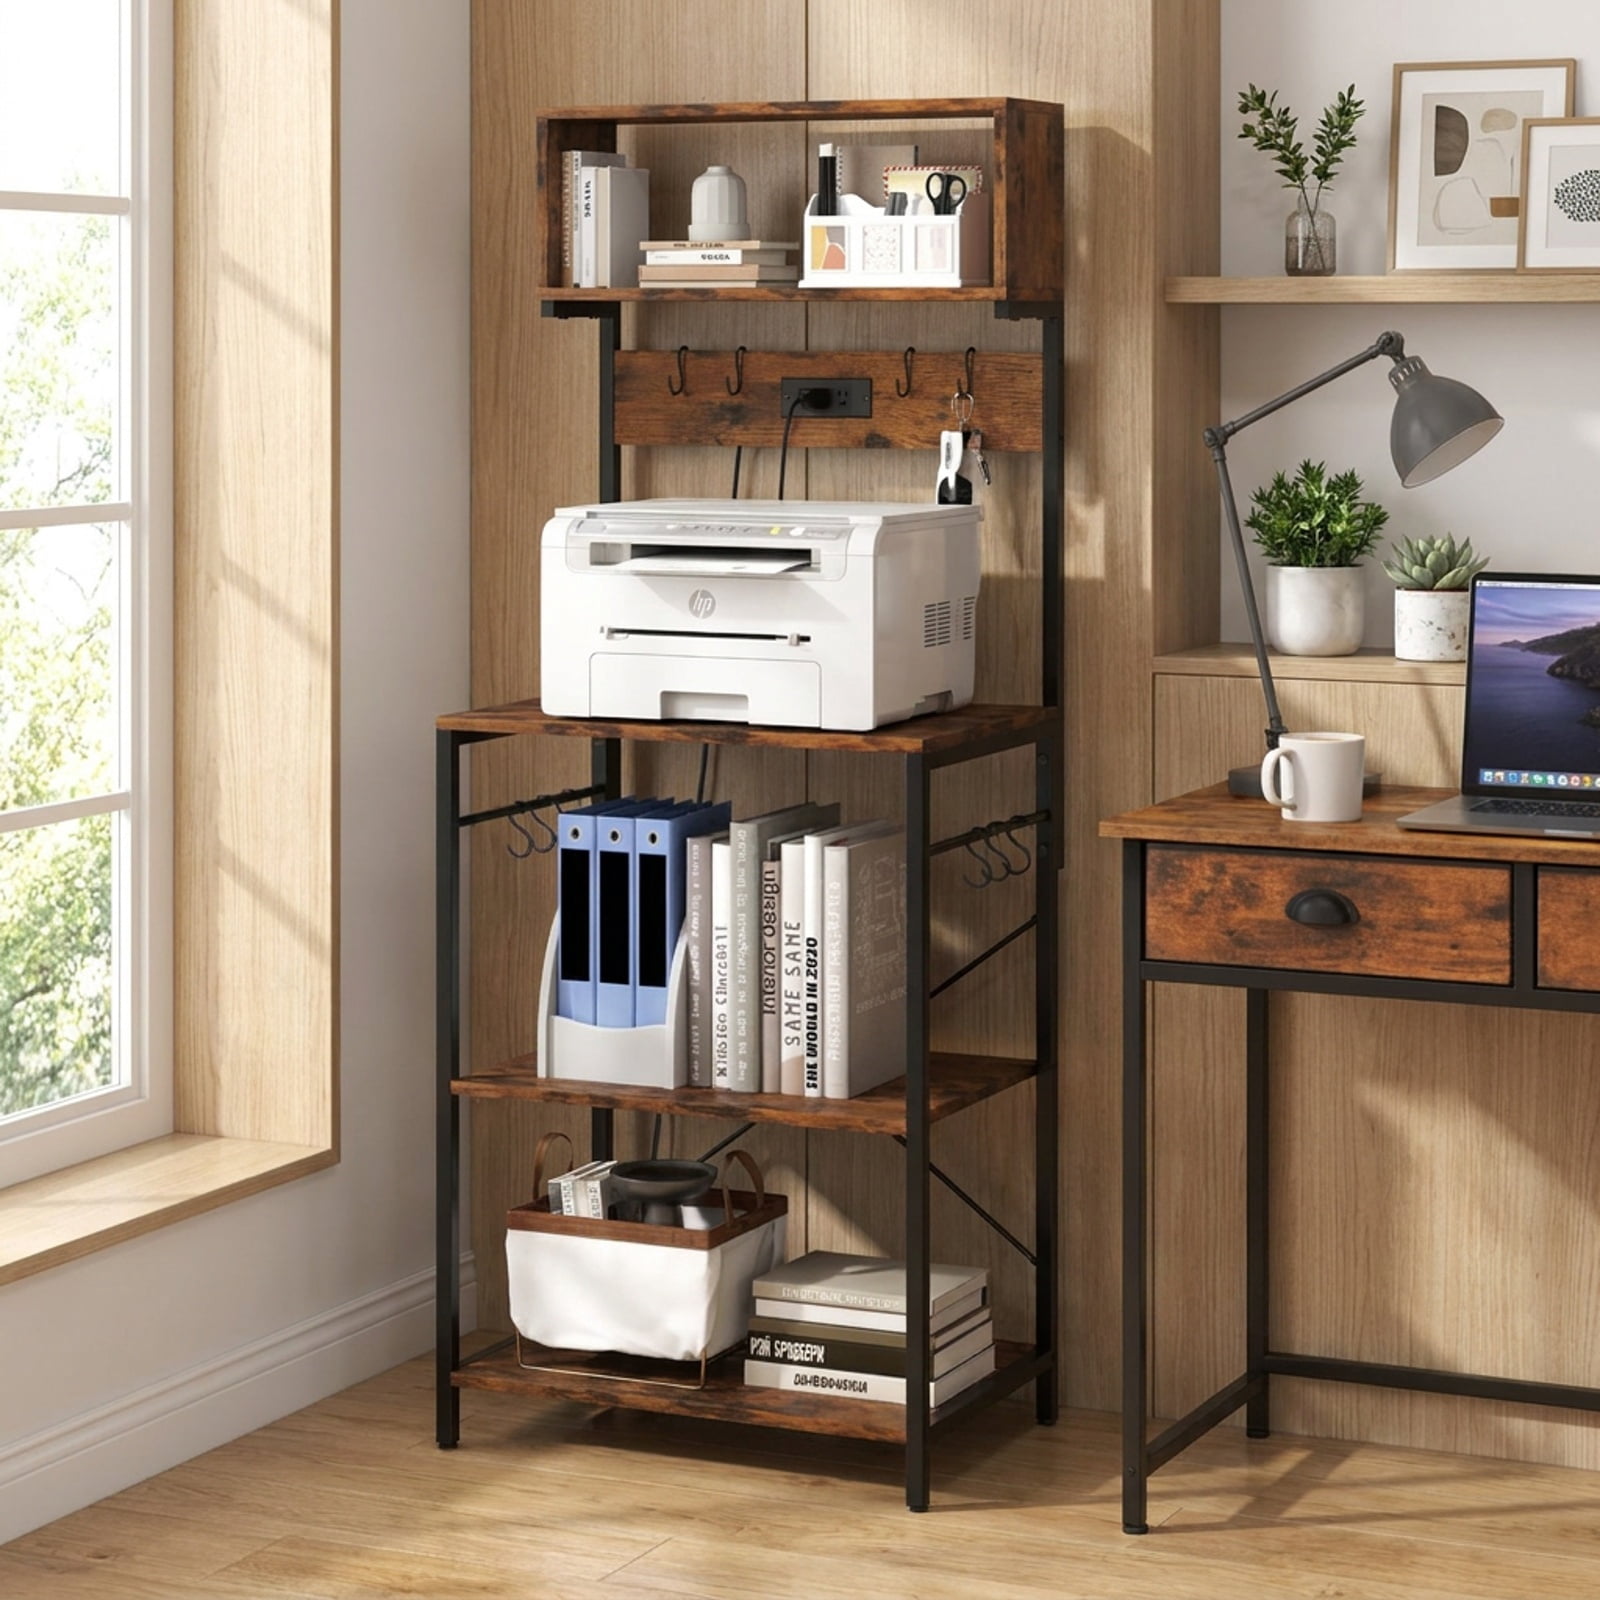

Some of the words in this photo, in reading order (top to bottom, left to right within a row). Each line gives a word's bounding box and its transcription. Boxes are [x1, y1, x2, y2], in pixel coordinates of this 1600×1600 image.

[691, 590, 715, 618] hp
[784, 920, 801, 977] SAME
[784, 989, 801, 1047] SAME
